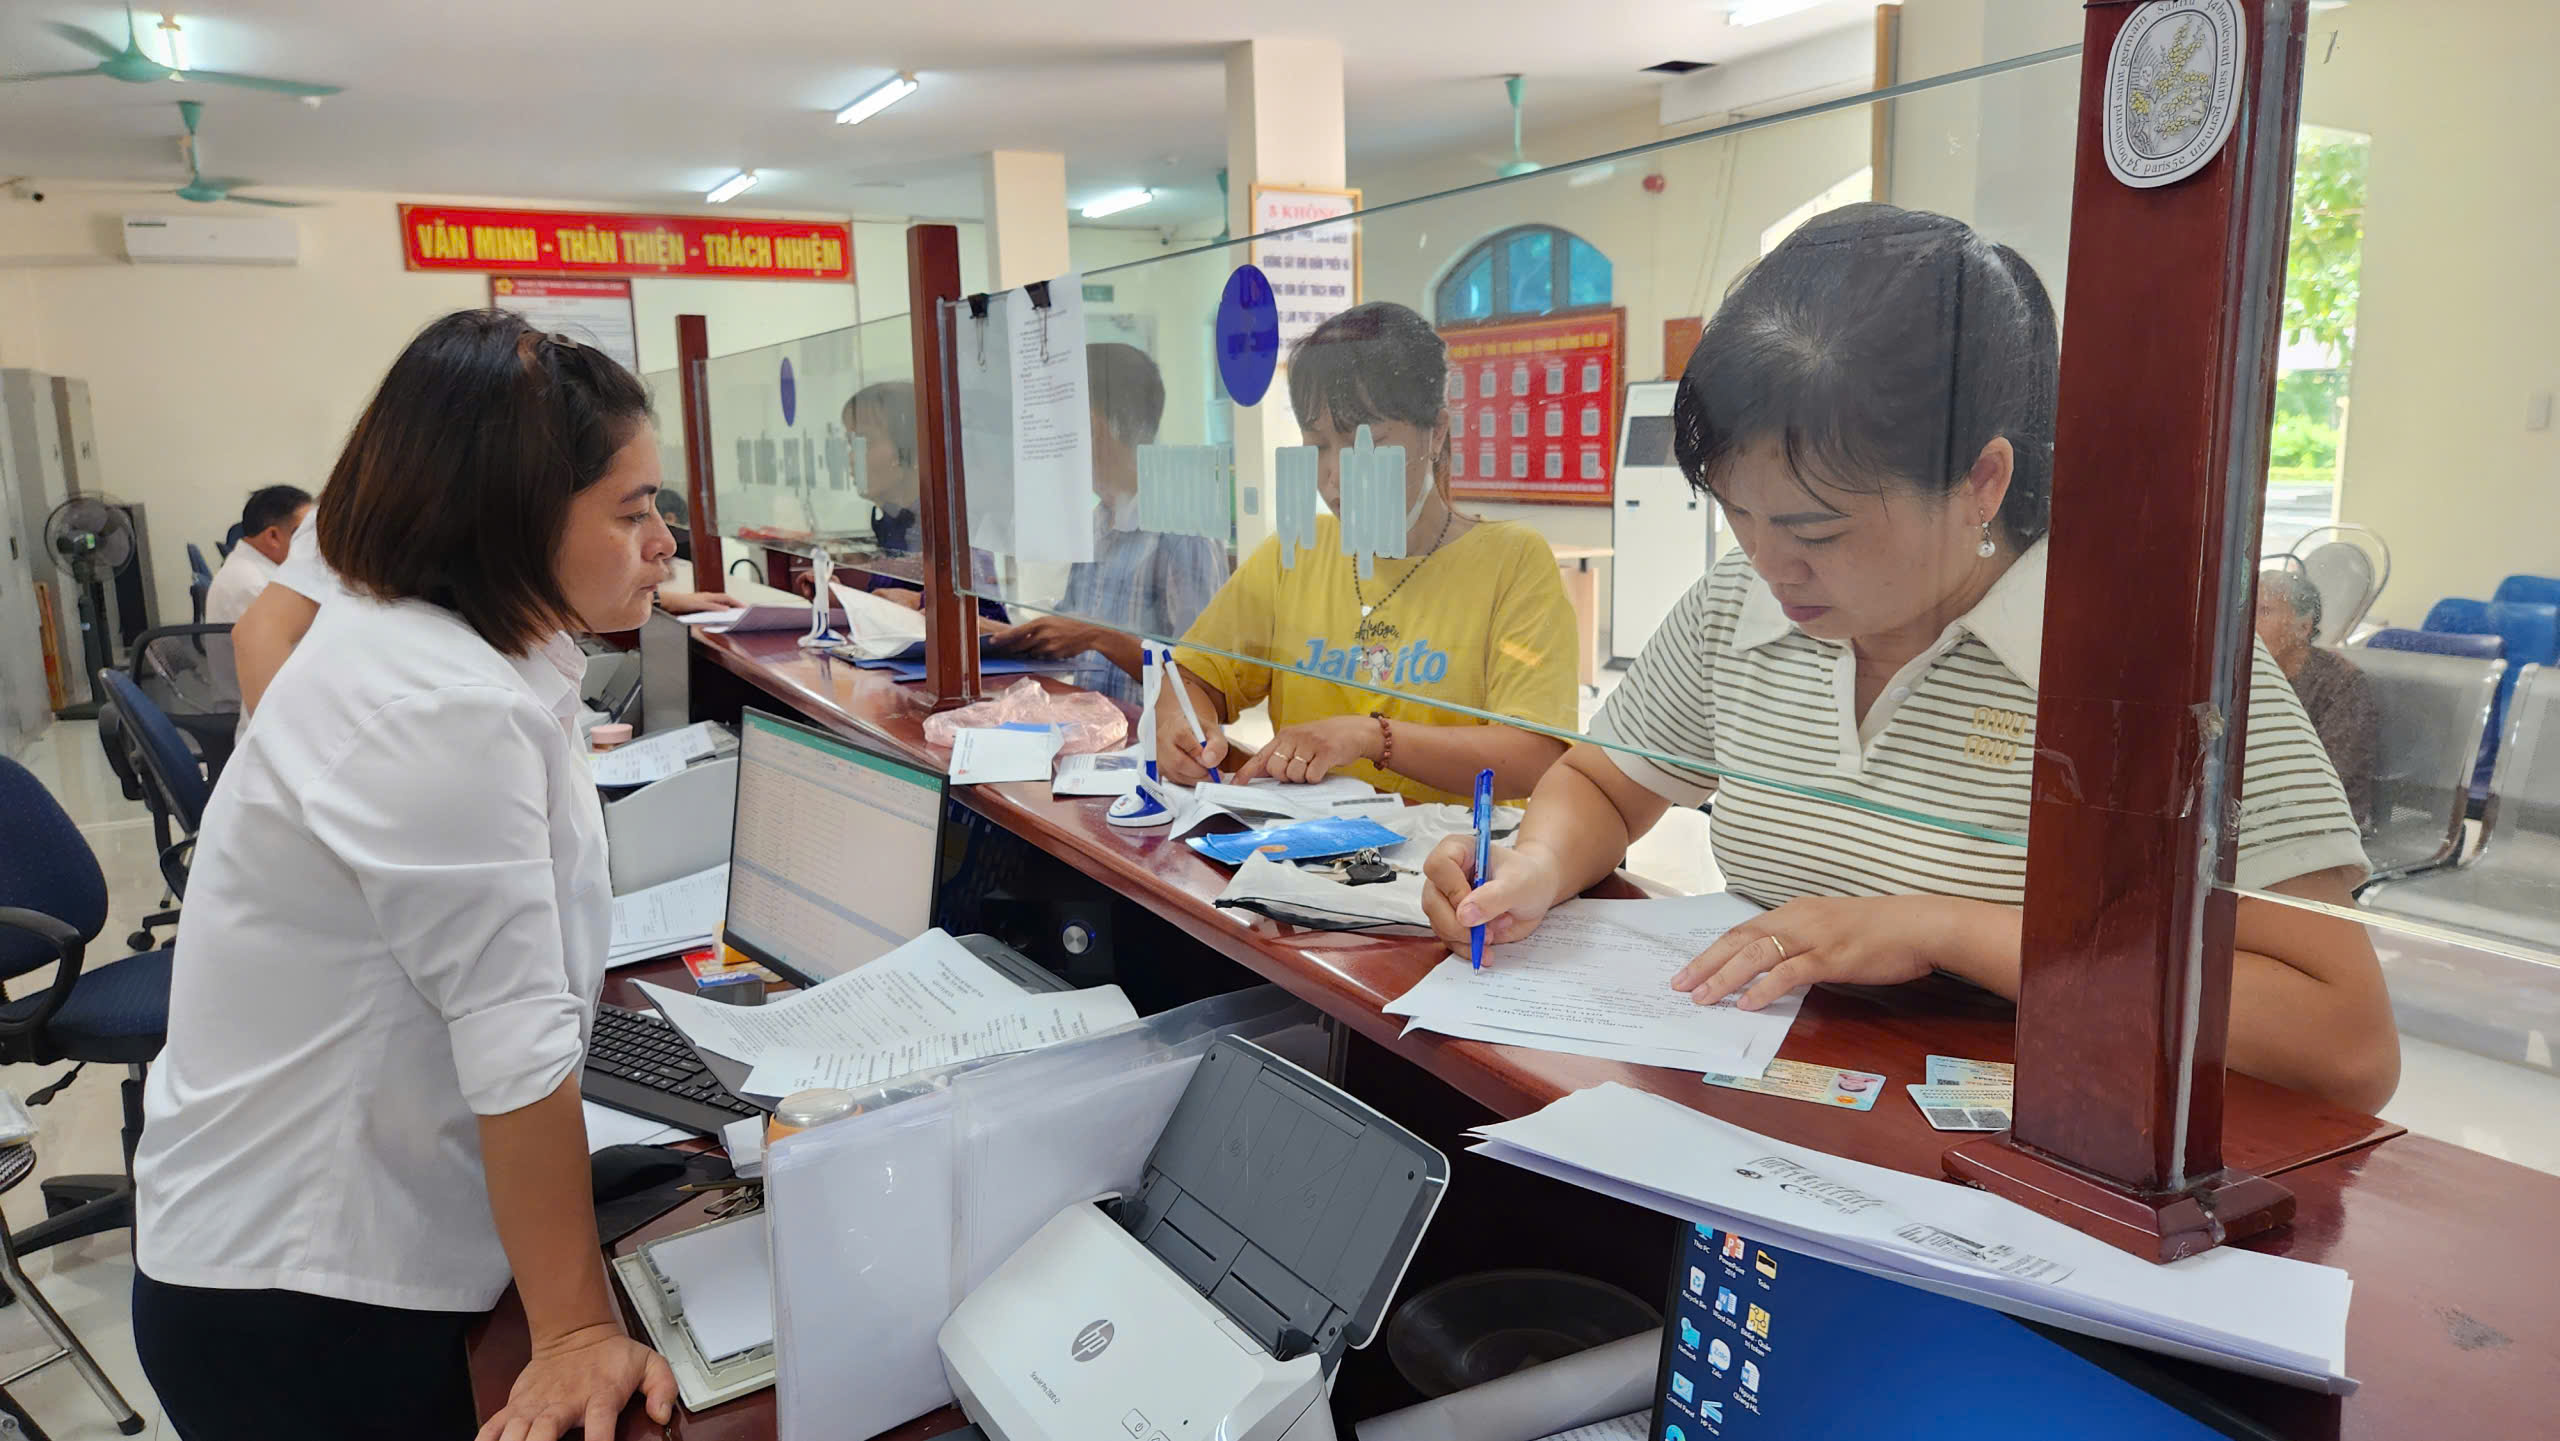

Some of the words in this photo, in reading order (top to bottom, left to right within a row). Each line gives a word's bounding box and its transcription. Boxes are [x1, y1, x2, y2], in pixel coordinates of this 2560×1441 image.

[2120, 16, 2148, 67] germain
[2216, 2, 2232, 66] boulevard
[2115, 69, 2125, 101] saint
[2217, 70, 2229, 103] saint
[2113, 105, 2129, 165] boulevard
[2190, 105, 2222, 157] germain
[416, 218, 469, 259] VĂN
[472, 226, 539, 261] MINH
[556, 224, 618, 263] THÂN
[620, 226, 686, 272] THIỆN
[702, 228, 772, 268] TRÁCH
[774, 232, 842, 277] NHIỆM
[1718, 1254, 1745, 1275] PowerPoint
[1682, 1289, 1699, 1304] Recycle
[1712, 1309, 1726, 1323] Word
[1711, 1367, 1722, 1379] Zalo
[1666, 1393, 1683, 1409] Control
[1682, 1405, 1695, 1418] Panel
[1708, 1424, 1720, 1436] Scan
